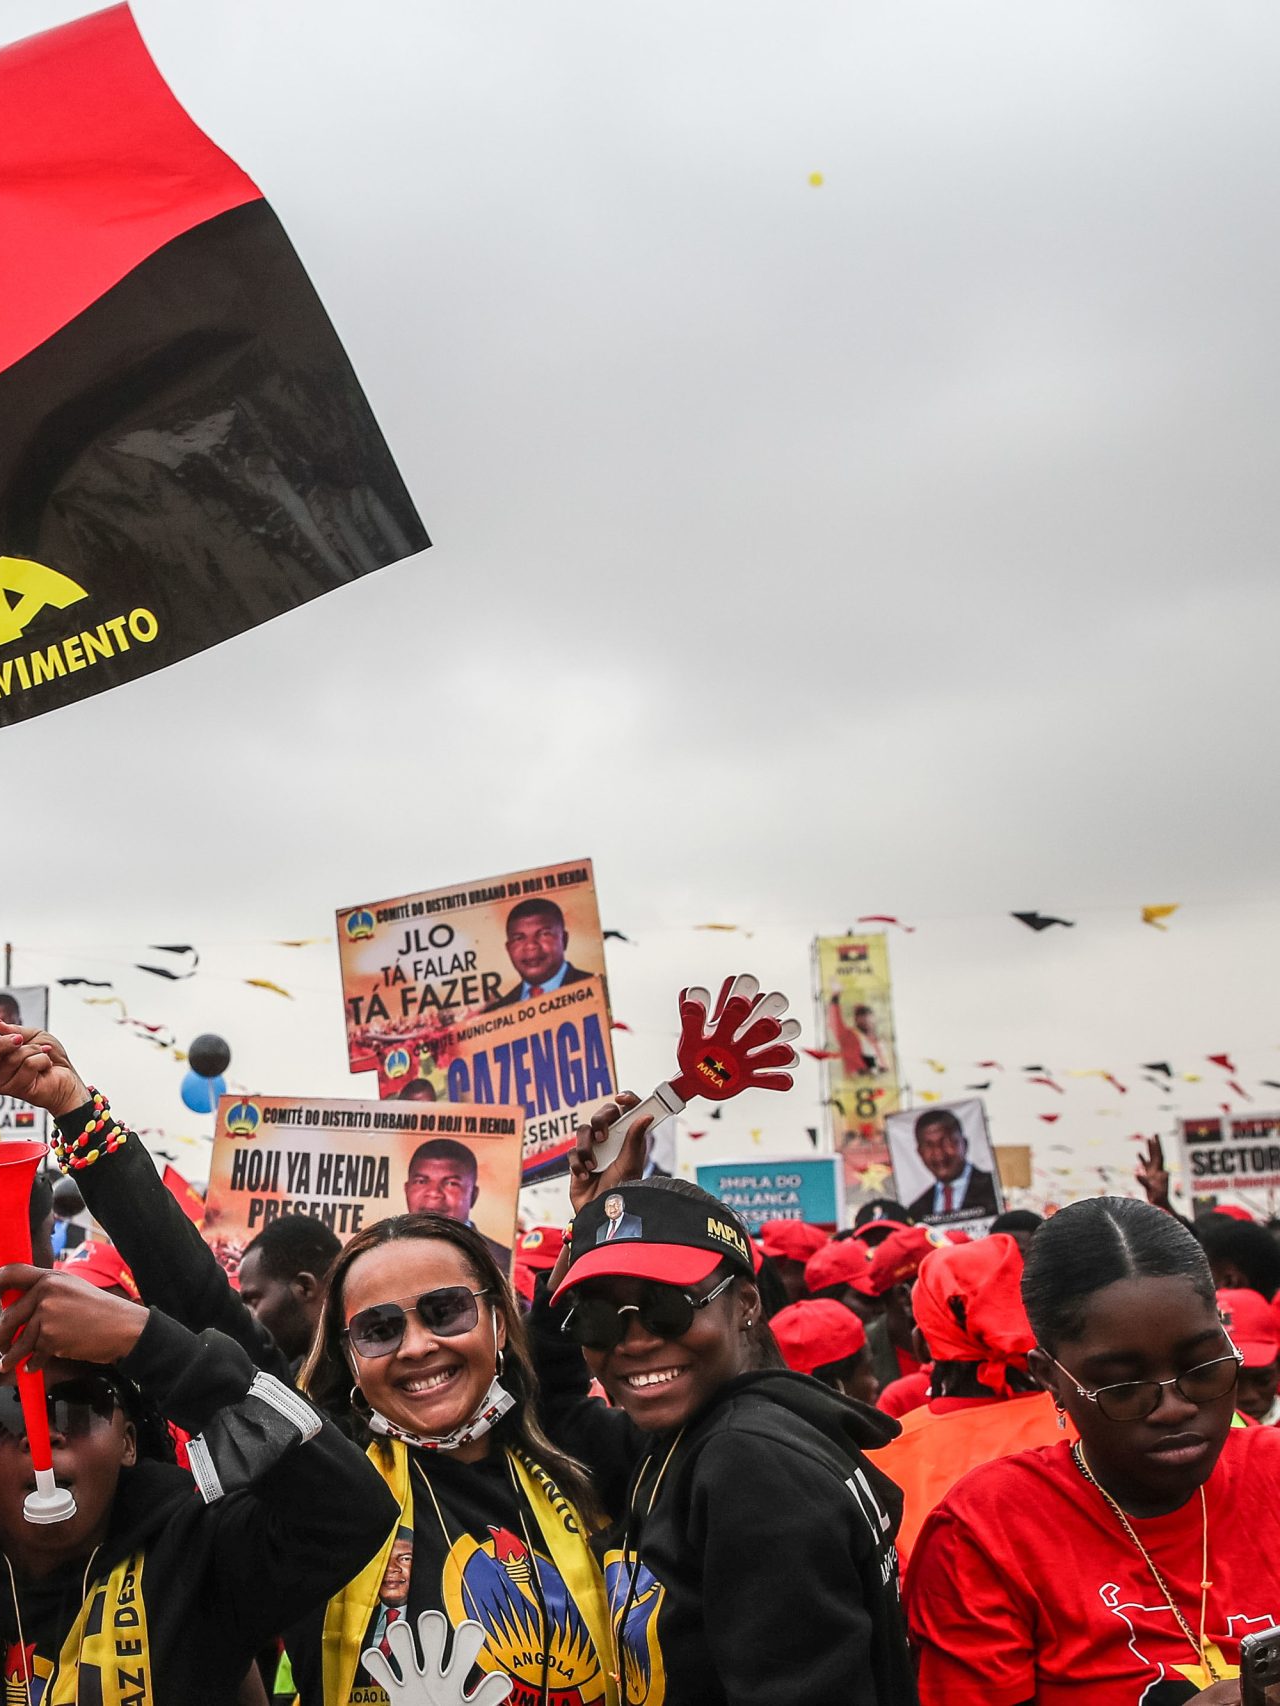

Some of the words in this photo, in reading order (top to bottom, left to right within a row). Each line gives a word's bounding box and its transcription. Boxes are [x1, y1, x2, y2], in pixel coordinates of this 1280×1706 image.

[376, 903, 411, 923] COMITÉ
[411, 902, 427, 917] DO
[426, 892, 468, 914] DISTRITO
[469, 885, 506, 905] URBANO
[507, 880, 522, 897] DO
[522, 876, 543, 894] HOJI
[544, 874, 556, 889] YA
[557, 867, 589, 887] HENDA
[398, 923, 454, 956] JLO
[381, 957, 407, 987] TÁ
[413, 950, 477, 981] FALAR
[348, 983, 389, 1026] TÁ
[401, 971, 507, 1017] FAZER
[457, 1016, 515, 1042] MUNICIPAL
[518, 1006, 536, 1023] DO
[539, 986, 595, 1014] CAZENGA
[696, 1062, 724, 1088] MPLA
[856, 1087, 877, 1119] 8
[262, 1106, 303, 1125] COMITÉ
[304, 1110, 320, 1126] DO
[321, 1111, 371, 1128] DISTRITO
[373, 1112, 418, 1131] URBANO
[420, 1115, 435, 1131] DO
[438, 1115, 461, 1132] HOJI
[464, 1117, 478, 1133] YA
[479, 1117, 515, 1135] HENDA
[230, 1148, 281, 1193] HOJI
[286, 1152, 310, 1195] YA
[316, 1154, 389, 1199] HENDA
[775, 1174, 803, 1189] DO
[707, 1217, 749, 1258] MPLA
[115, 1638, 143, 1657] E
[512, 1651, 576, 1681] ANGOLA
[348, 1688, 378, 1703] JOÃO
